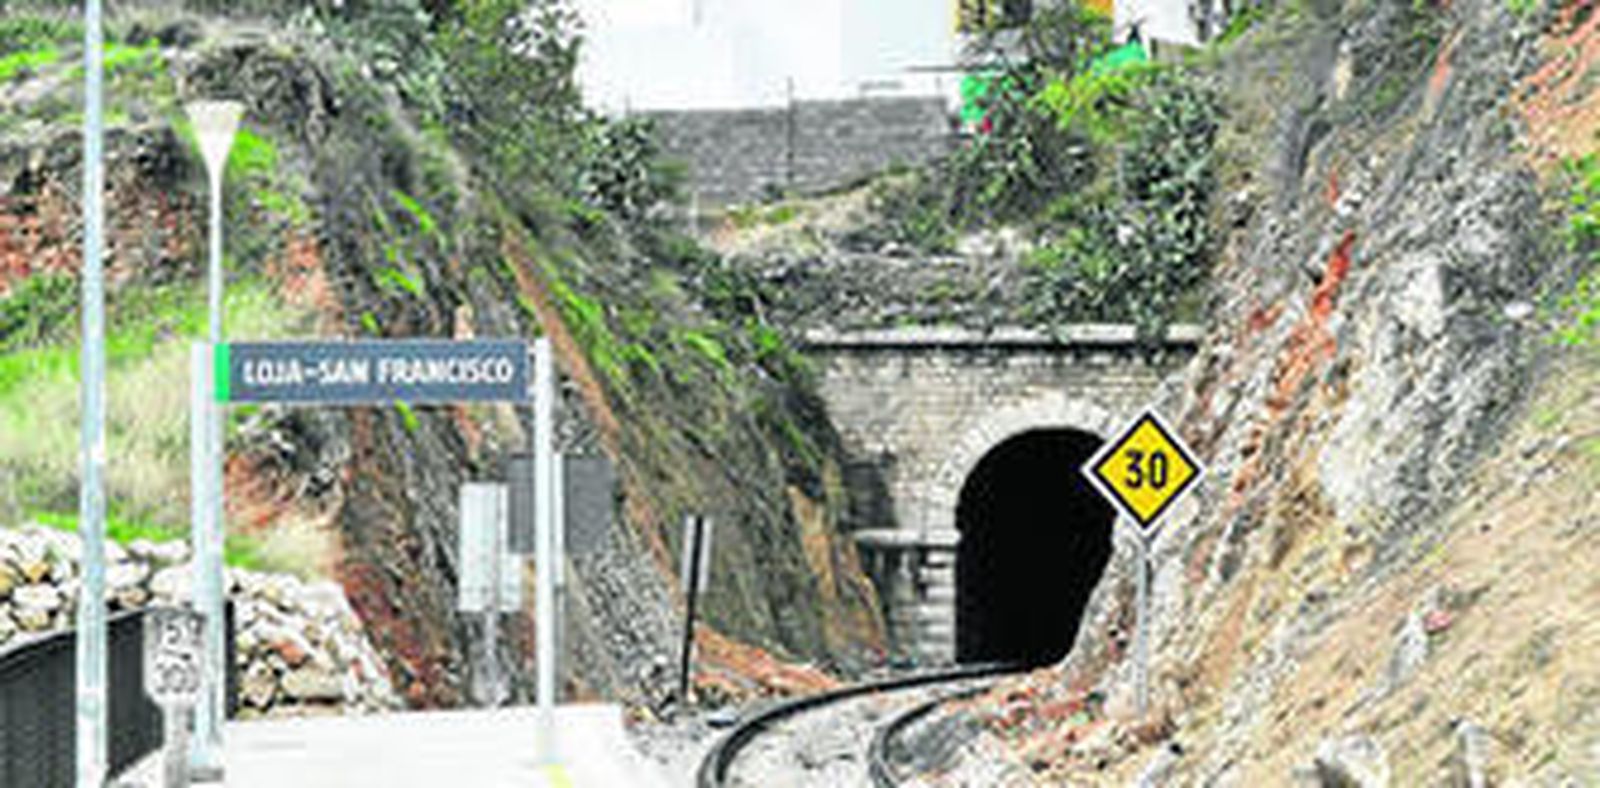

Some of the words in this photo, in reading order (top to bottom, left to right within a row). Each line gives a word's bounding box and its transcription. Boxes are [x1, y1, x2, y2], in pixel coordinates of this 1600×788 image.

[242, 359, 371, 384] LOJA-SAN
[379, 358, 514, 383] FRANCISCO
[1124, 450, 1168, 490] 30
